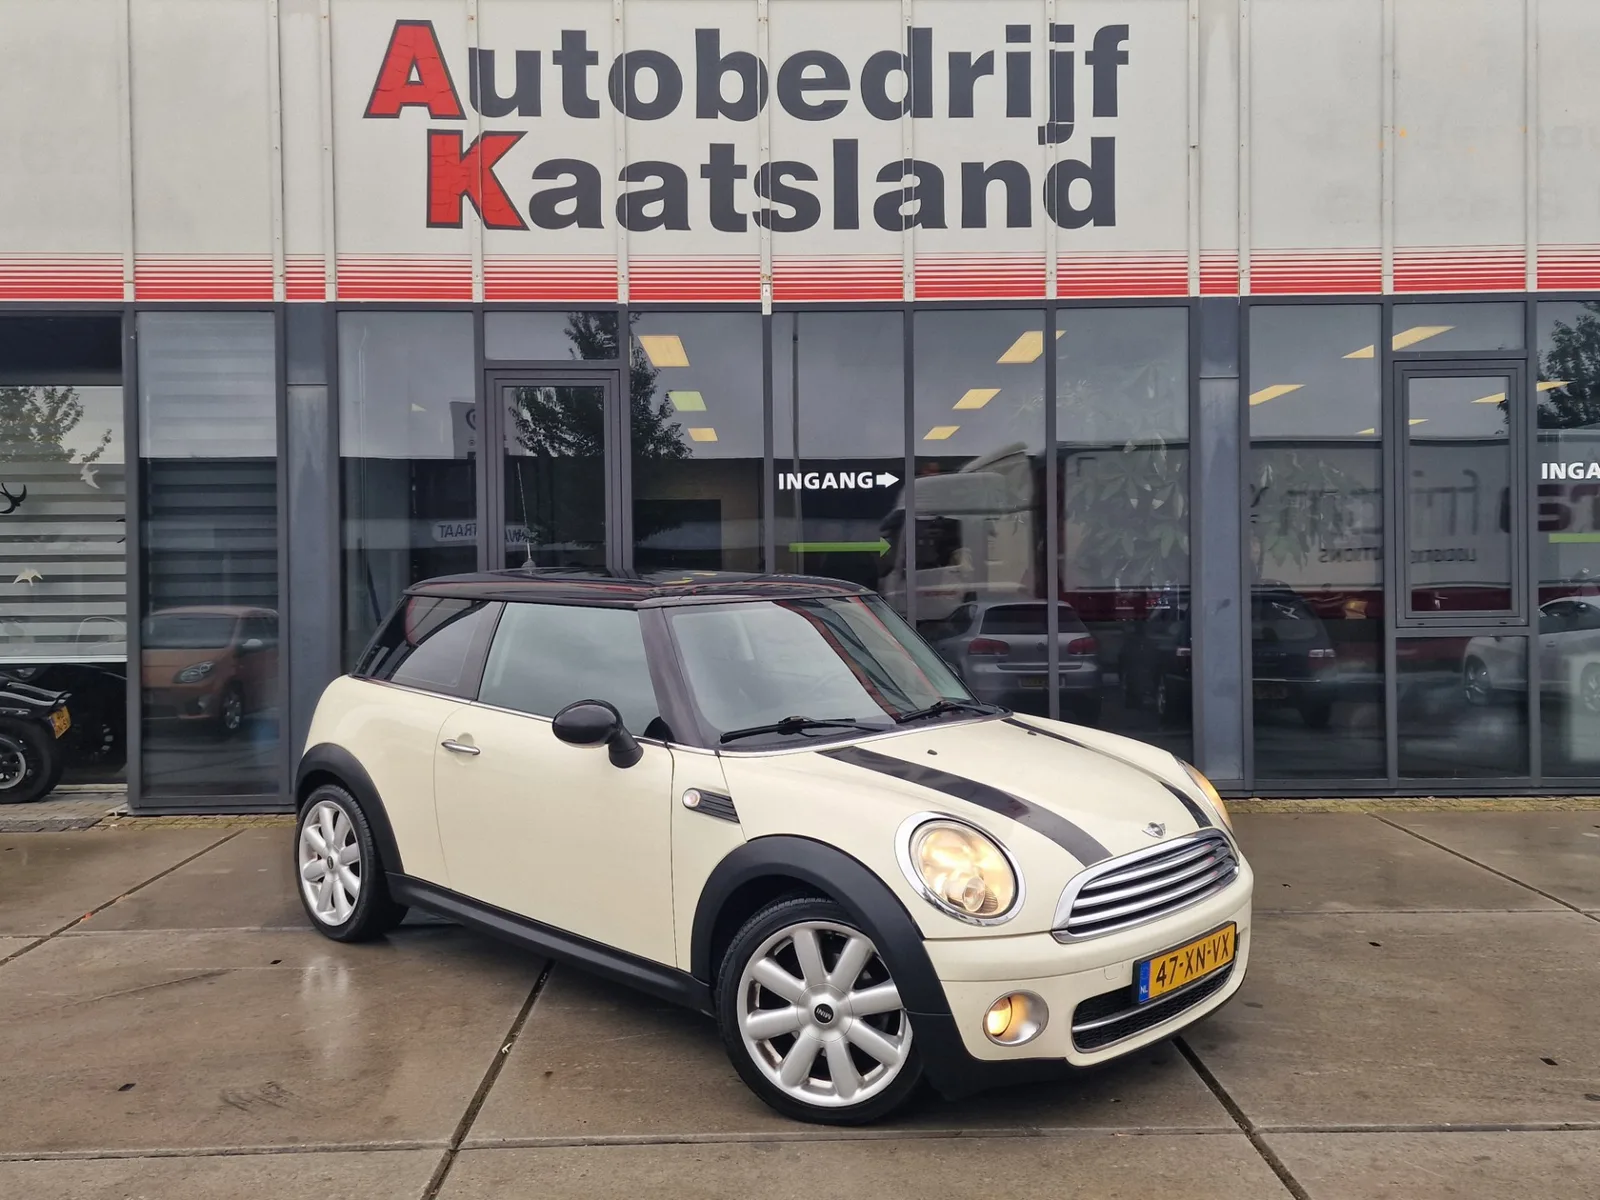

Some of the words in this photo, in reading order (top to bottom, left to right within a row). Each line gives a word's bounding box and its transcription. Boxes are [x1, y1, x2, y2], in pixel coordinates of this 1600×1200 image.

[363, 19, 1129, 144] Autobedrijf
[426, 128, 1116, 232] Kaatsland
[778, 471, 873, 490] INGANG
[1156, 931, 1230, 988] 47-XN-VX
[1140, 985, 1149, 995] NL
